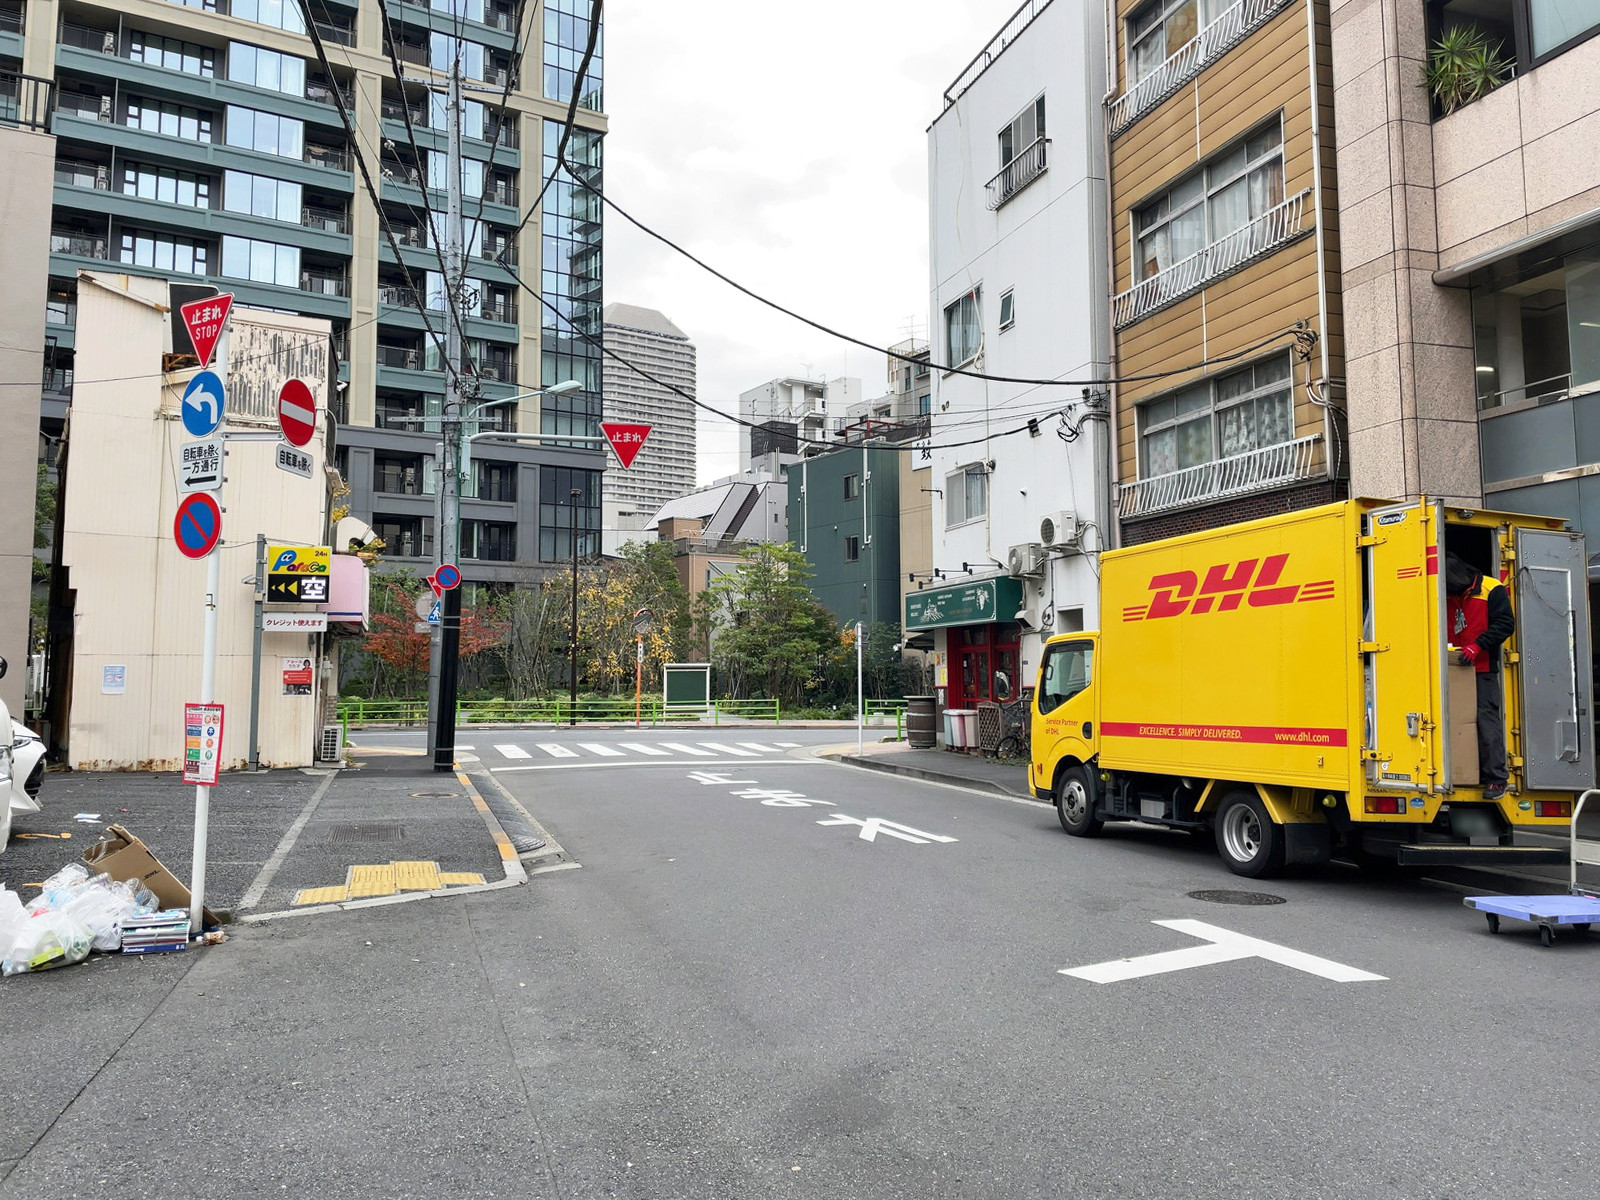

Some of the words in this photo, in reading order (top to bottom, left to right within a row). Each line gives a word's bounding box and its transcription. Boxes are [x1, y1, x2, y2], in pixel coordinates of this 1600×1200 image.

[191, 305, 222, 325] 止まれ
[195, 325, 217, 340] STOP
[611, 431, 643, 443] 止まれ
[183, 444, 219, 461] 自転車を除く
[279, 449, 311, 473] 自転車を除く
[183, 459, 218, 474] 一方通行
[300, 577, 326, 600] 空
[1146, 553, 1301, 620] DHL
[266, 619, 323, 627] クレジット使えます
[1045, 718, 1061, 726] Service
[1061, 719, 1078, 727] Partner
[1139, 726, 1176, 737] EXCELLENCE.
[1178, 728, 1202, 738] SIMPLY
[1203, 729, 1243, 740] DELIVERED.
[1274, 731, 1330, 743] www.dhl.com
